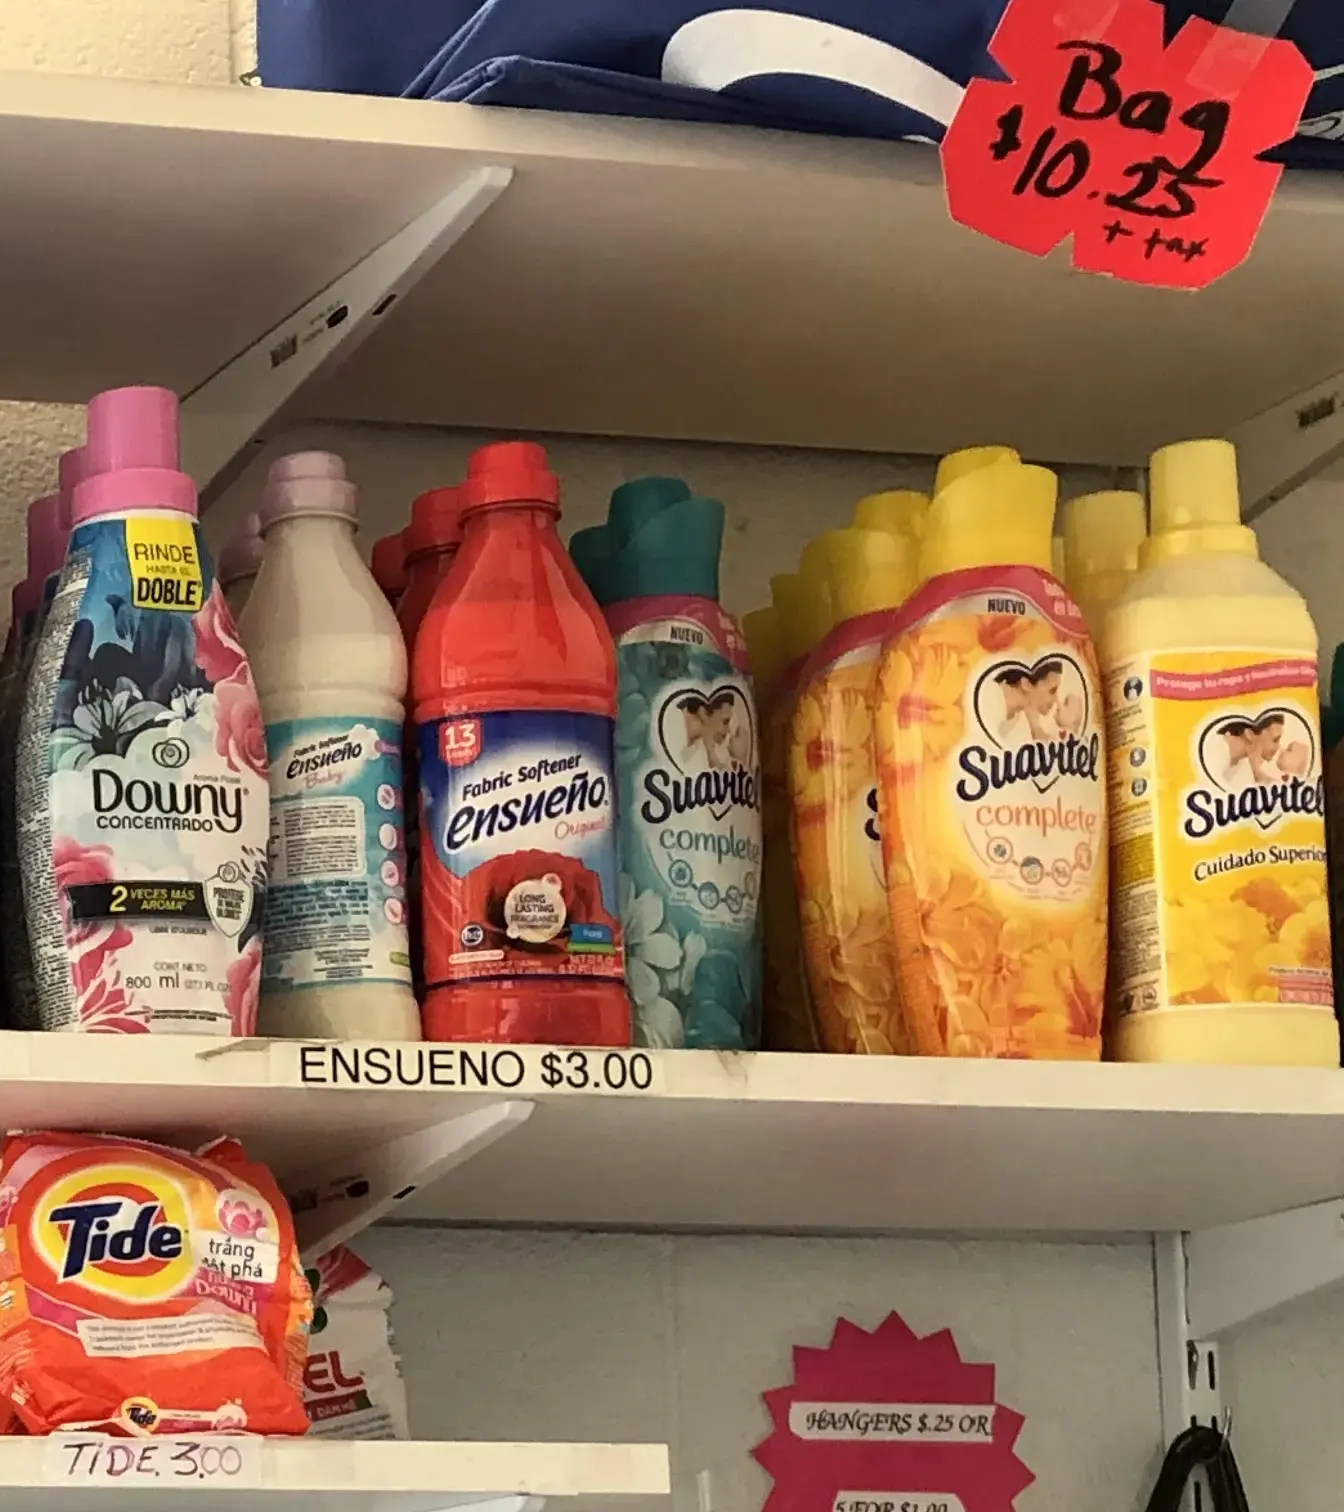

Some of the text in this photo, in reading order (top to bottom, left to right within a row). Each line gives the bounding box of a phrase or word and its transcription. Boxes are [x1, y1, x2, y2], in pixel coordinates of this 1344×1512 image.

[1057, 40, 1230, 175] Bag
[444, 723, 476, 748] 13
[463, 754, 582, 801] Fabric Softener
[956, 733, 1100, 801] Suavitel
[92, 769, 242, 833] Downy
[97, 815, 212, 832] CONCENTRADO
[446, 772, 607, 850] ensueño
[130, 888, 195, 900] VECES MÁS
[298, 1046, 653, 1090] ENSUENO $3.00
[49, 1202, 182, 1280] Tide
[806, 1410, 993, 1436] HANGERS $.25 OR
